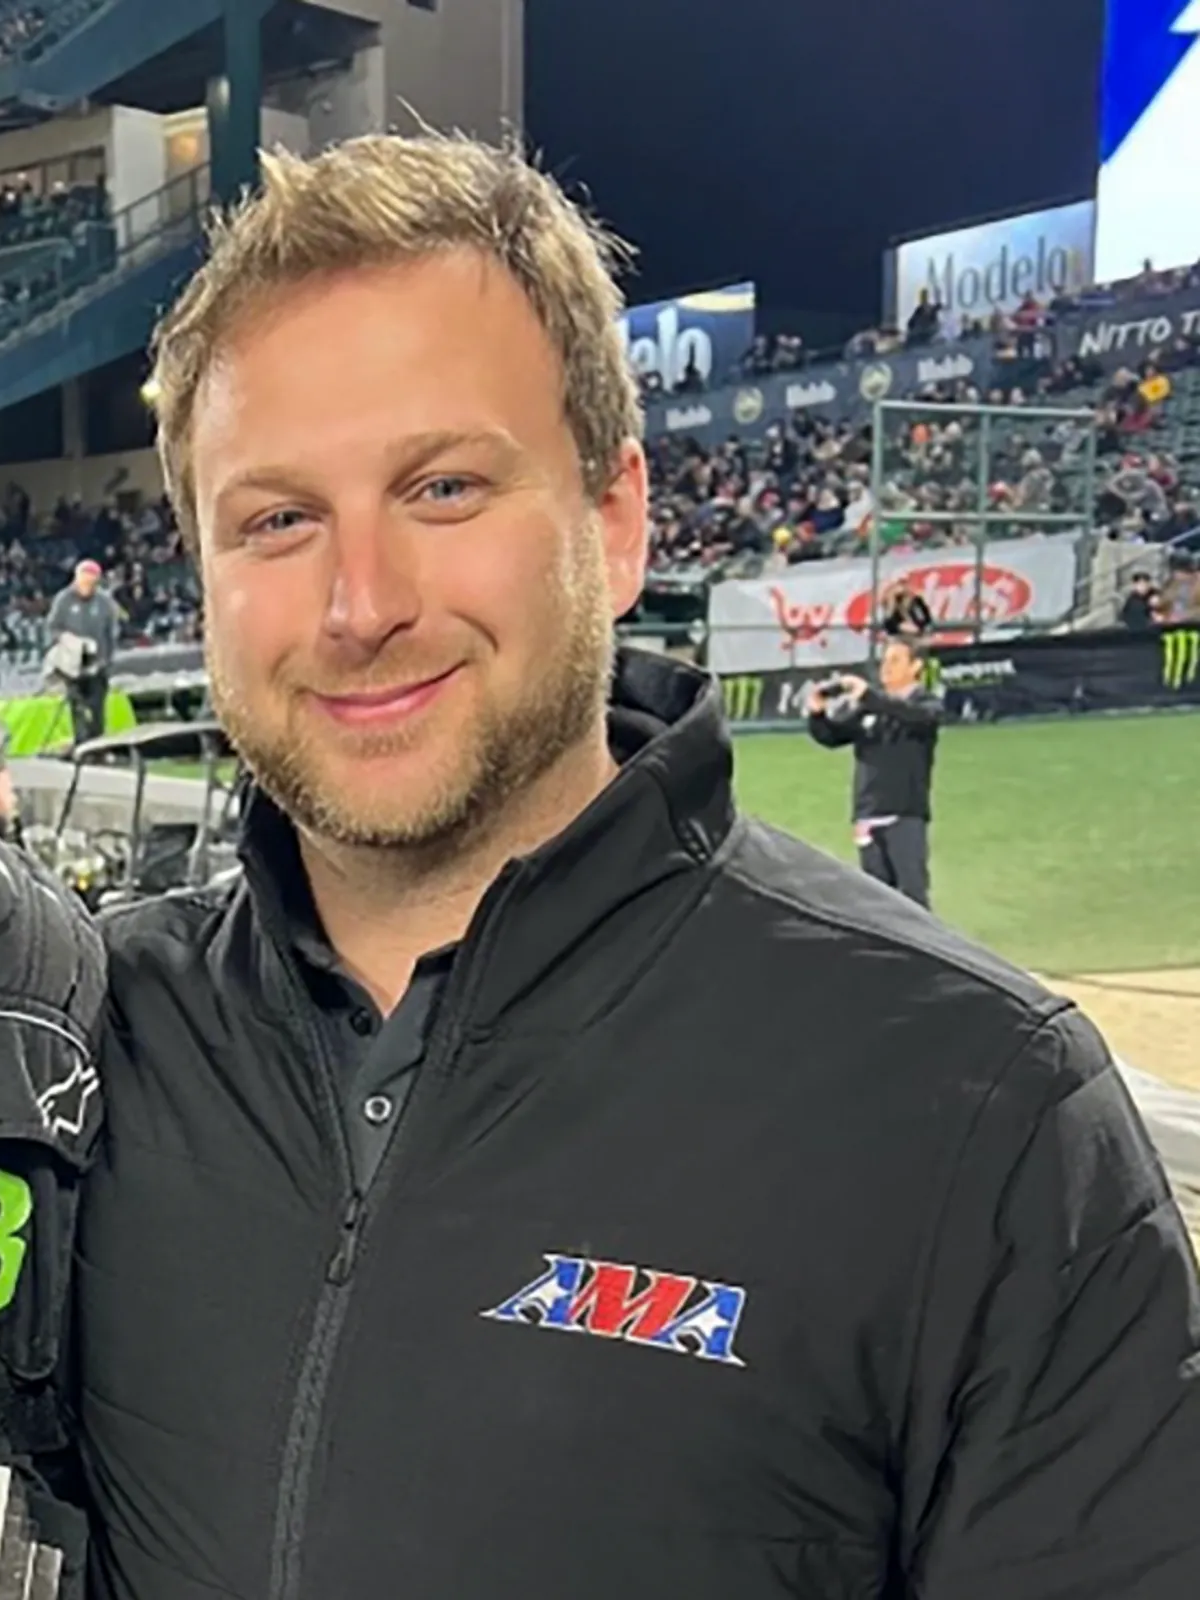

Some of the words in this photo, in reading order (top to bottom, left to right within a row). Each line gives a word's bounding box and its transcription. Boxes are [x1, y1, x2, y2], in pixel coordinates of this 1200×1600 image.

[927, 235, 1068, 310] Modelo
[1078, 316, 1173, 358] NITTO
[478, 1253, 749, 1367] AMA
